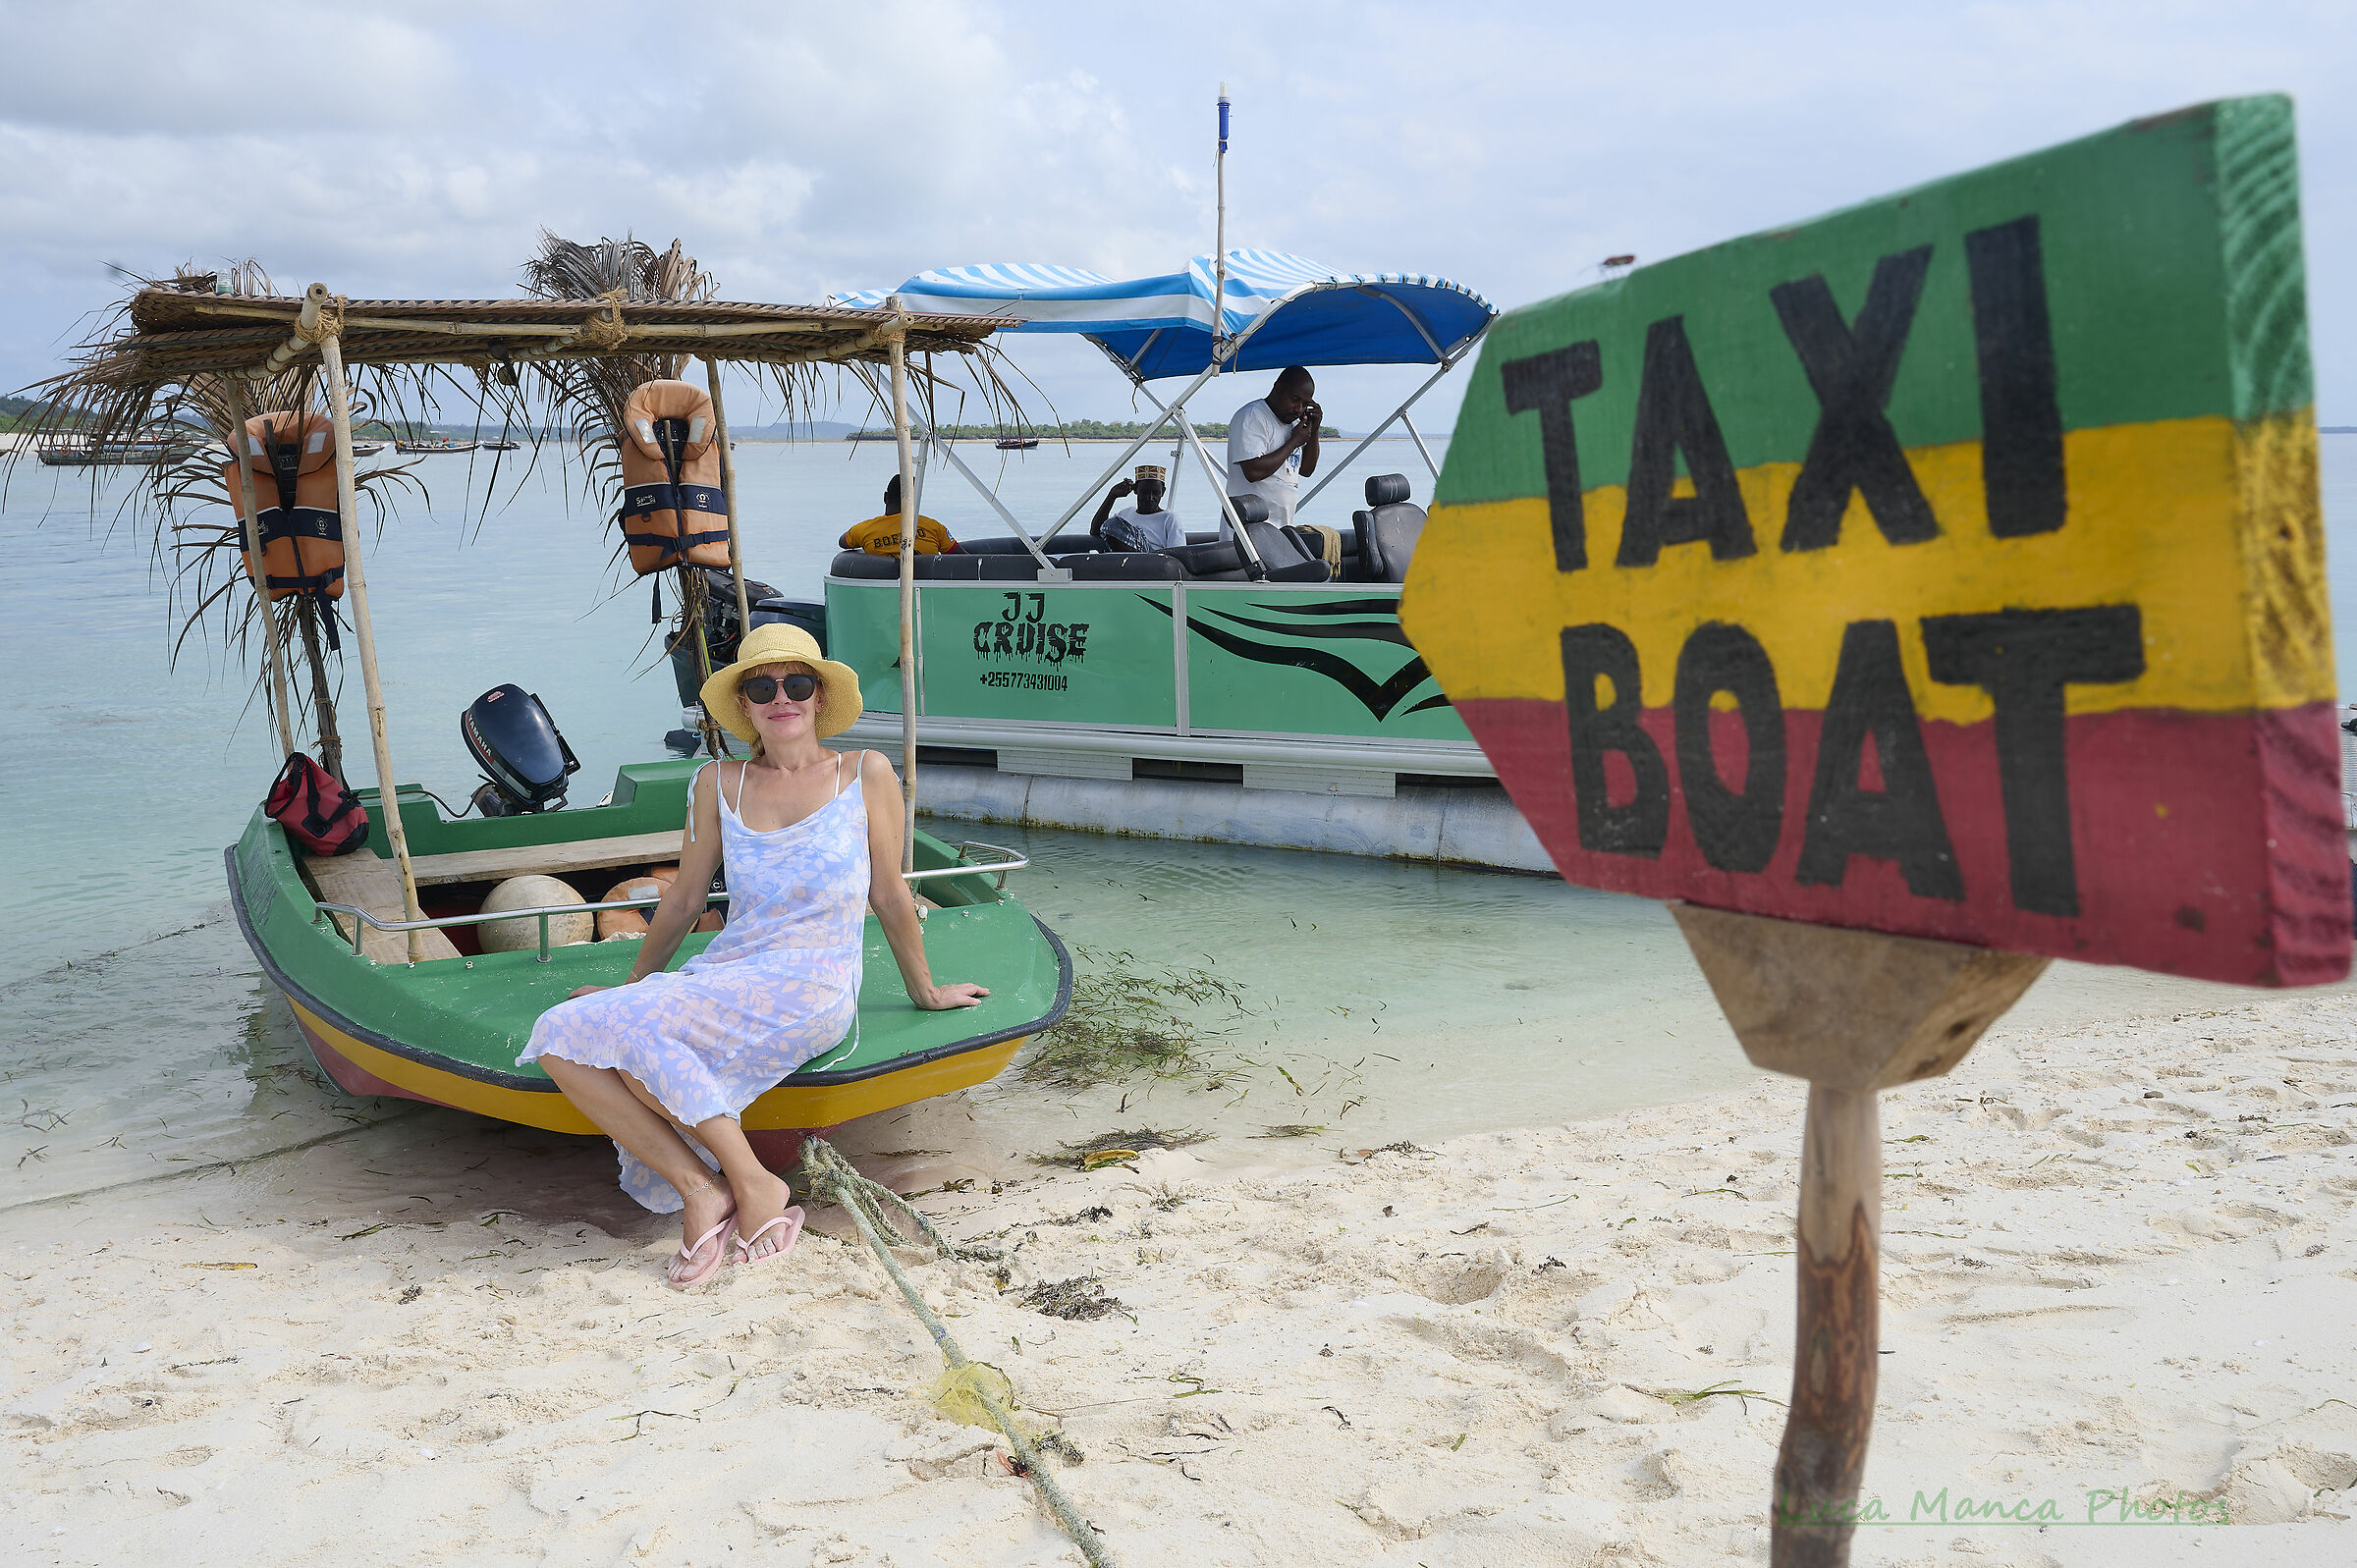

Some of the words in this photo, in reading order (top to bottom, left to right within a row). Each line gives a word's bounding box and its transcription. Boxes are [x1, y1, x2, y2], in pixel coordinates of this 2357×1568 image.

[1501, 214, 2067, 572] TAXI
[1001, 591, 1046, 623] JJ
[973, 622, 1090, 672] CRUISE
[980, 671, 1069, 692] +255773431004
[468, 714, 493, 757] YAMAHA
[1560, 603, 2147, 918] BOAT
